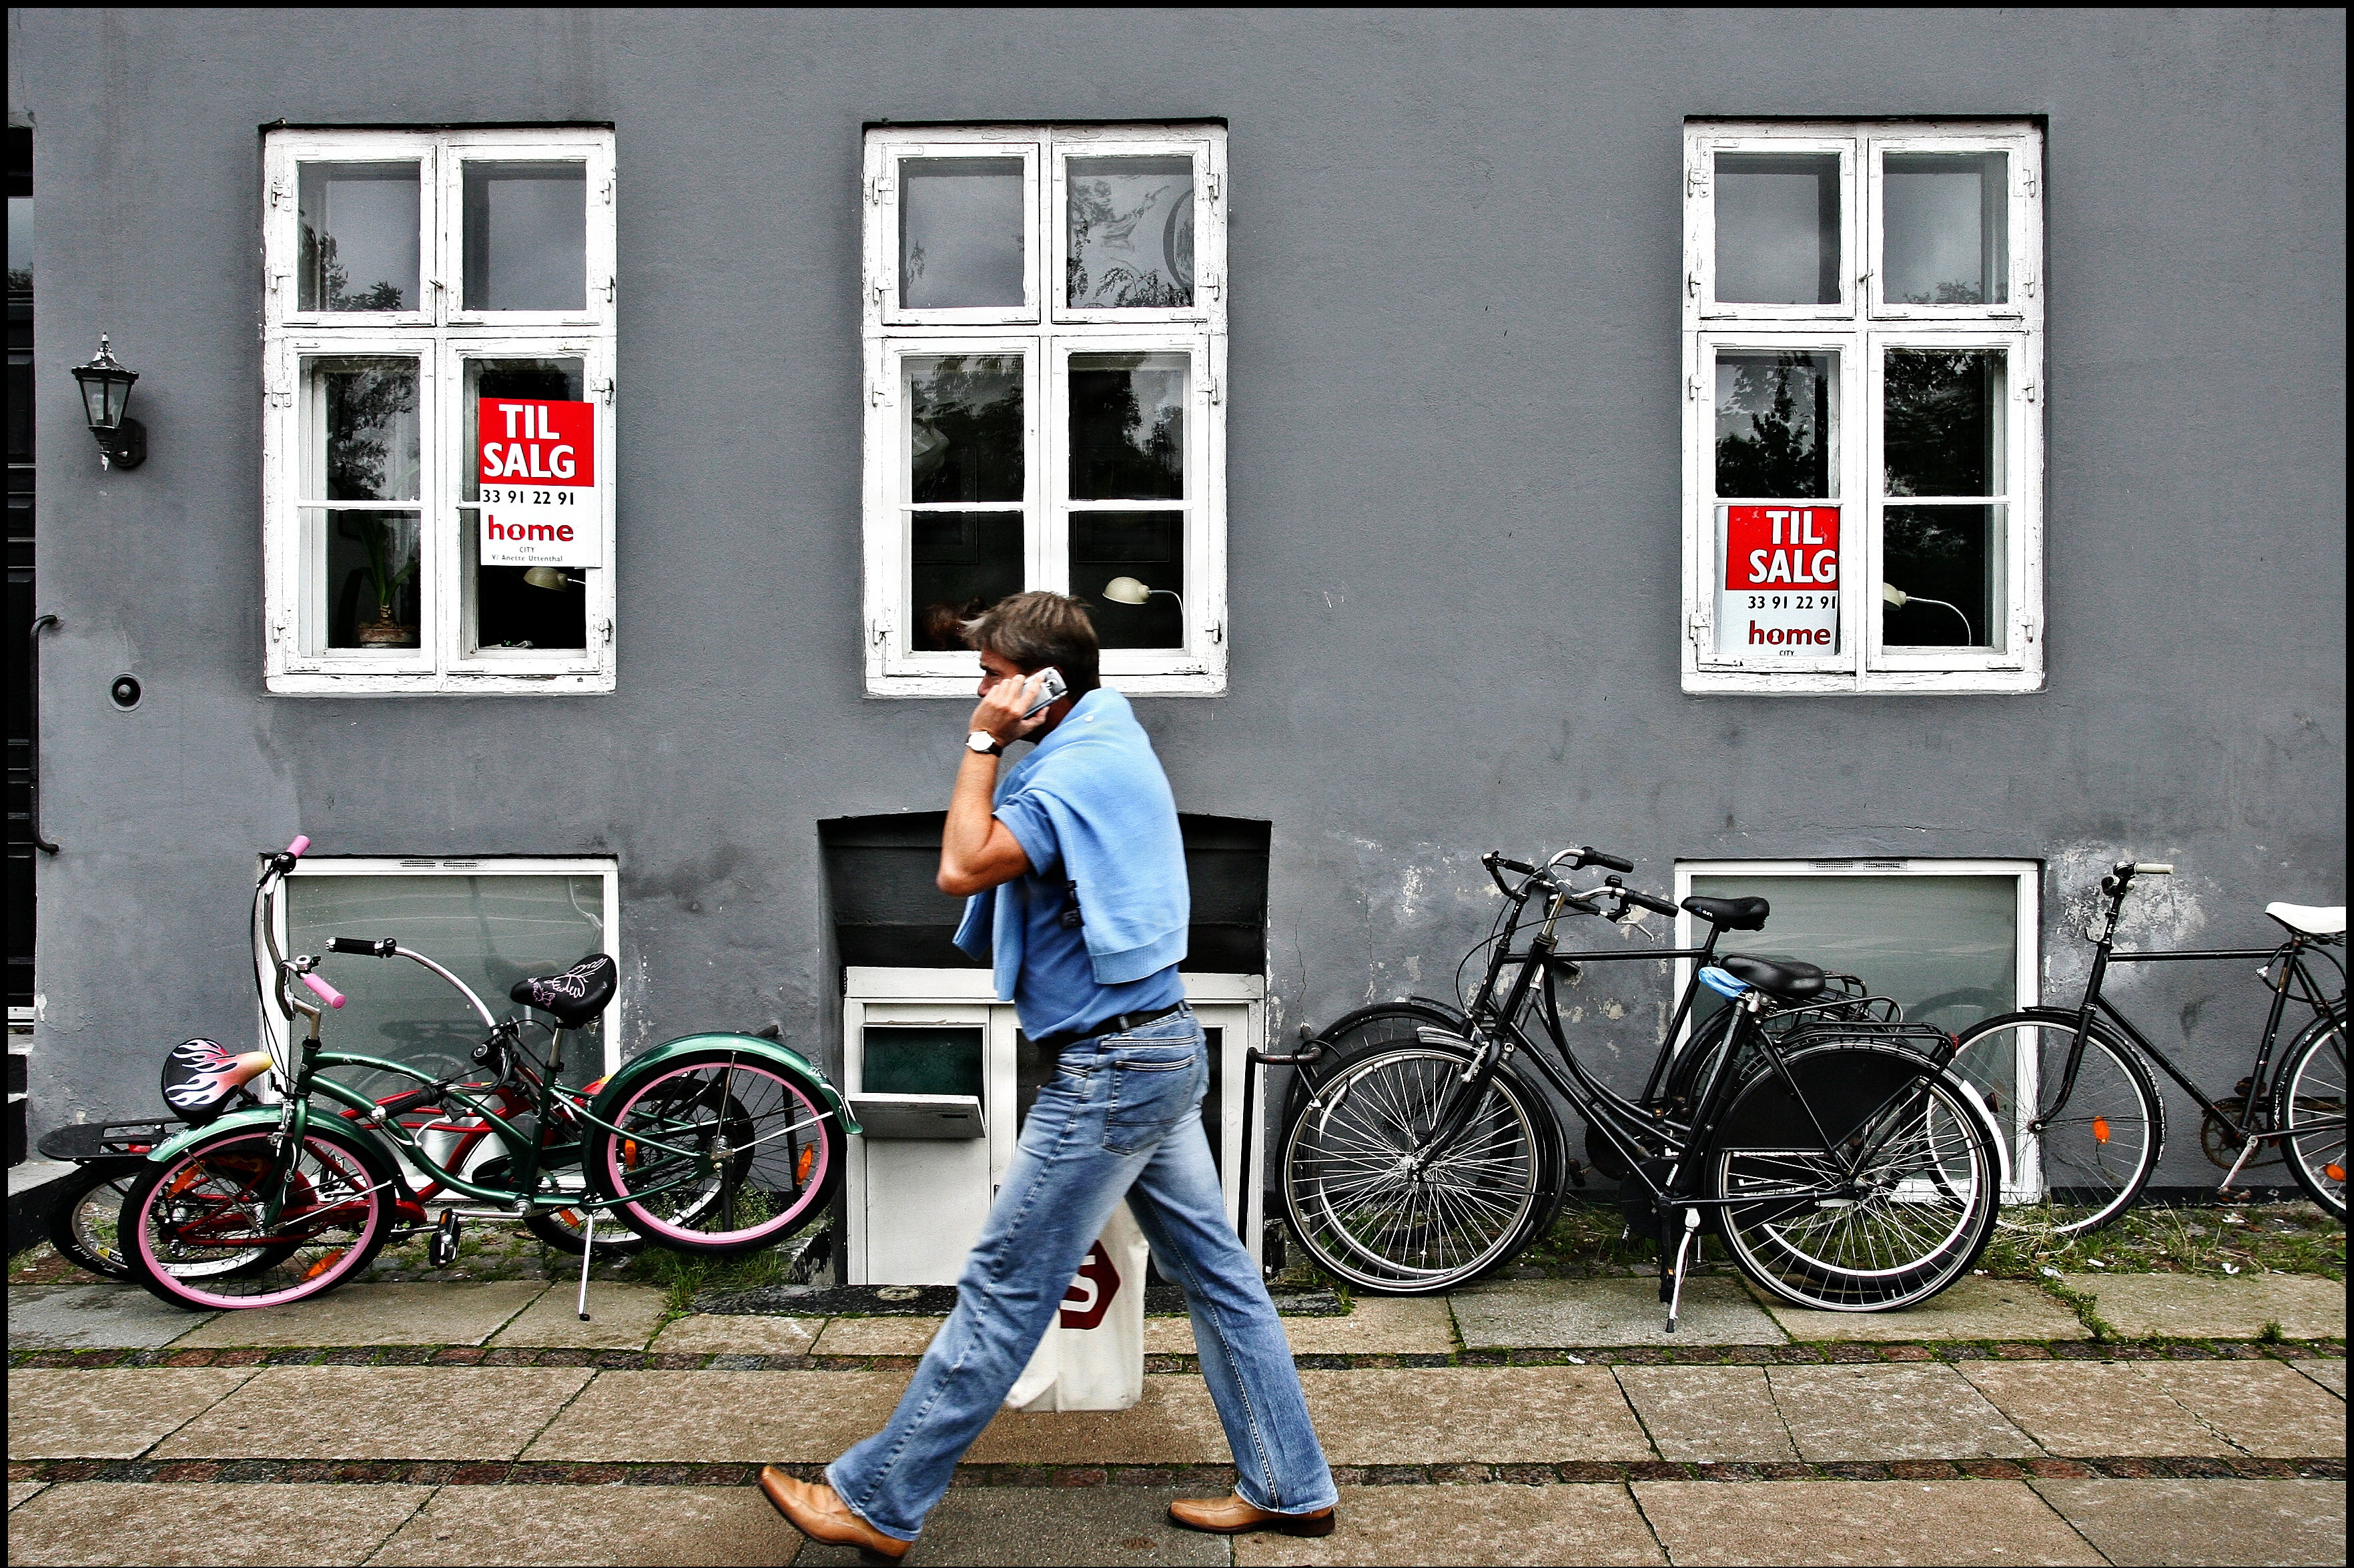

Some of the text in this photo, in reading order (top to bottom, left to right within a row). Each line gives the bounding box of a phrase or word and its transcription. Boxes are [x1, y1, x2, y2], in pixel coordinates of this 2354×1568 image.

[498, 404, 560, 440] TIL
[483, 442, 576, 479] SALG
[482, 489, 574, 505] 33 91 22 91
[488, 514, 574, 542] home
[1765, 510, 1824, 544] TIL
[1748, 548, 1837, 584] SALG
[1747, 596, 1836, 609] 33 91 22 91
[1749, 620, 1831, 645] home
